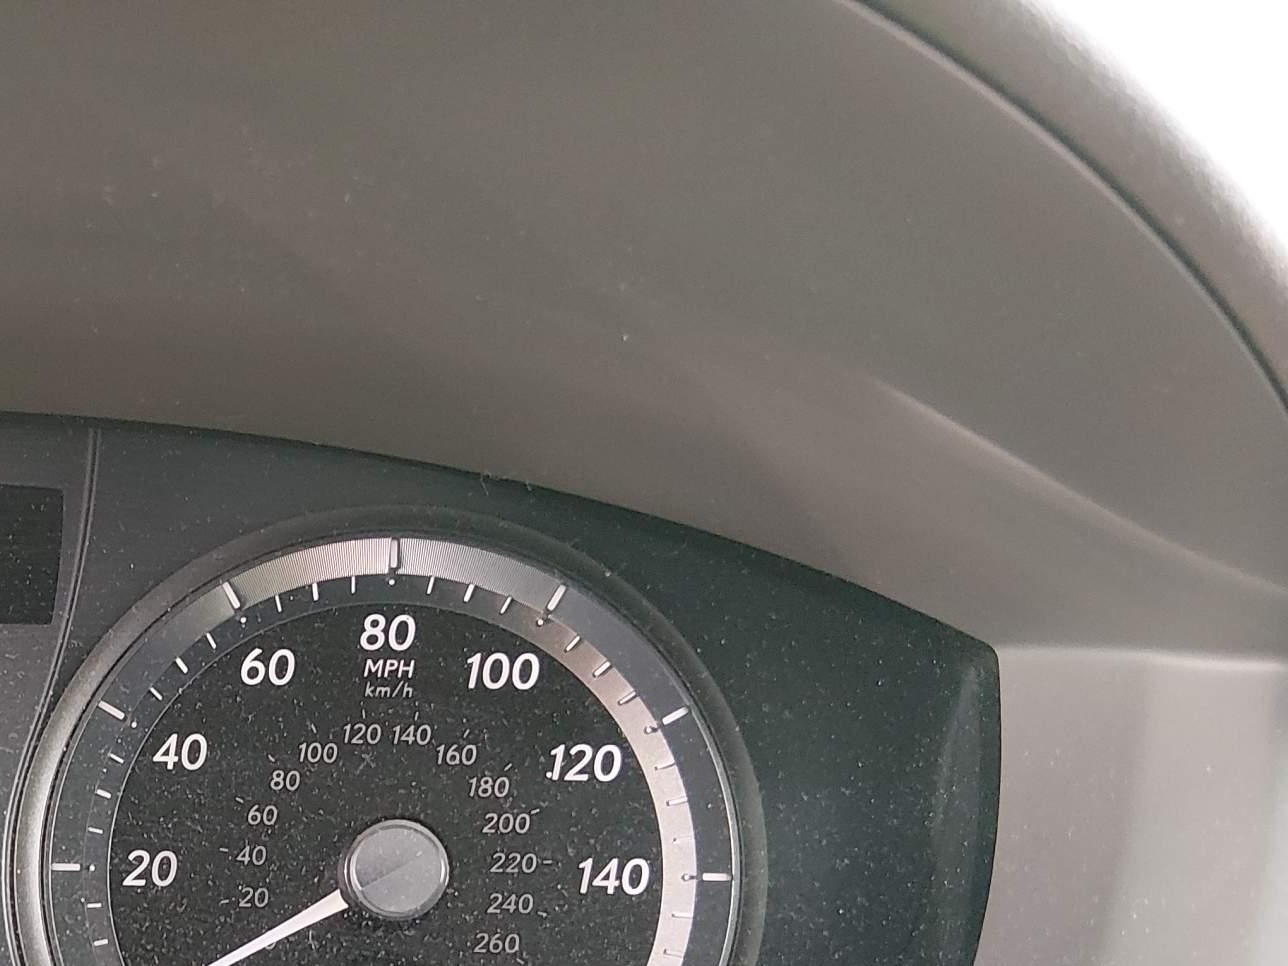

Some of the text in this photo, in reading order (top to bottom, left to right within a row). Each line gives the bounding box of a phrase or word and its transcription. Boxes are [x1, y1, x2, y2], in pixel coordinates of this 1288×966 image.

[360, 613, 417, 651] 80
[240, 648, 296, 686] 60
[363, 658, 415, 679] MPH
[465, 652, 540, 690] 100
[364, 680, 414, 699] km/h
[343, 723, 382, 745] 120
[392, 724, 432, 746] 140
[152, 733, 208, 770] 40
[298, 742, 338, 764] 100
[435, 744, 477, 766] 160
[547, 743, 622, 782] 120
[270, 770, 301, 791] 80
[468, 776, 510, 798] 180
[247, 804, 278, 826] 60
[482, 812, 530, 834] 200
[236, 845, 267, 866] 40
[489, 853, 537, 874] 220
[122, 849, 178, 887] 20
[577, 857, 650, 896] 140
[238, 887, 269, 908] 20
[487, 894, 534, 915] 240
[473, 932, 520, 954] 260
